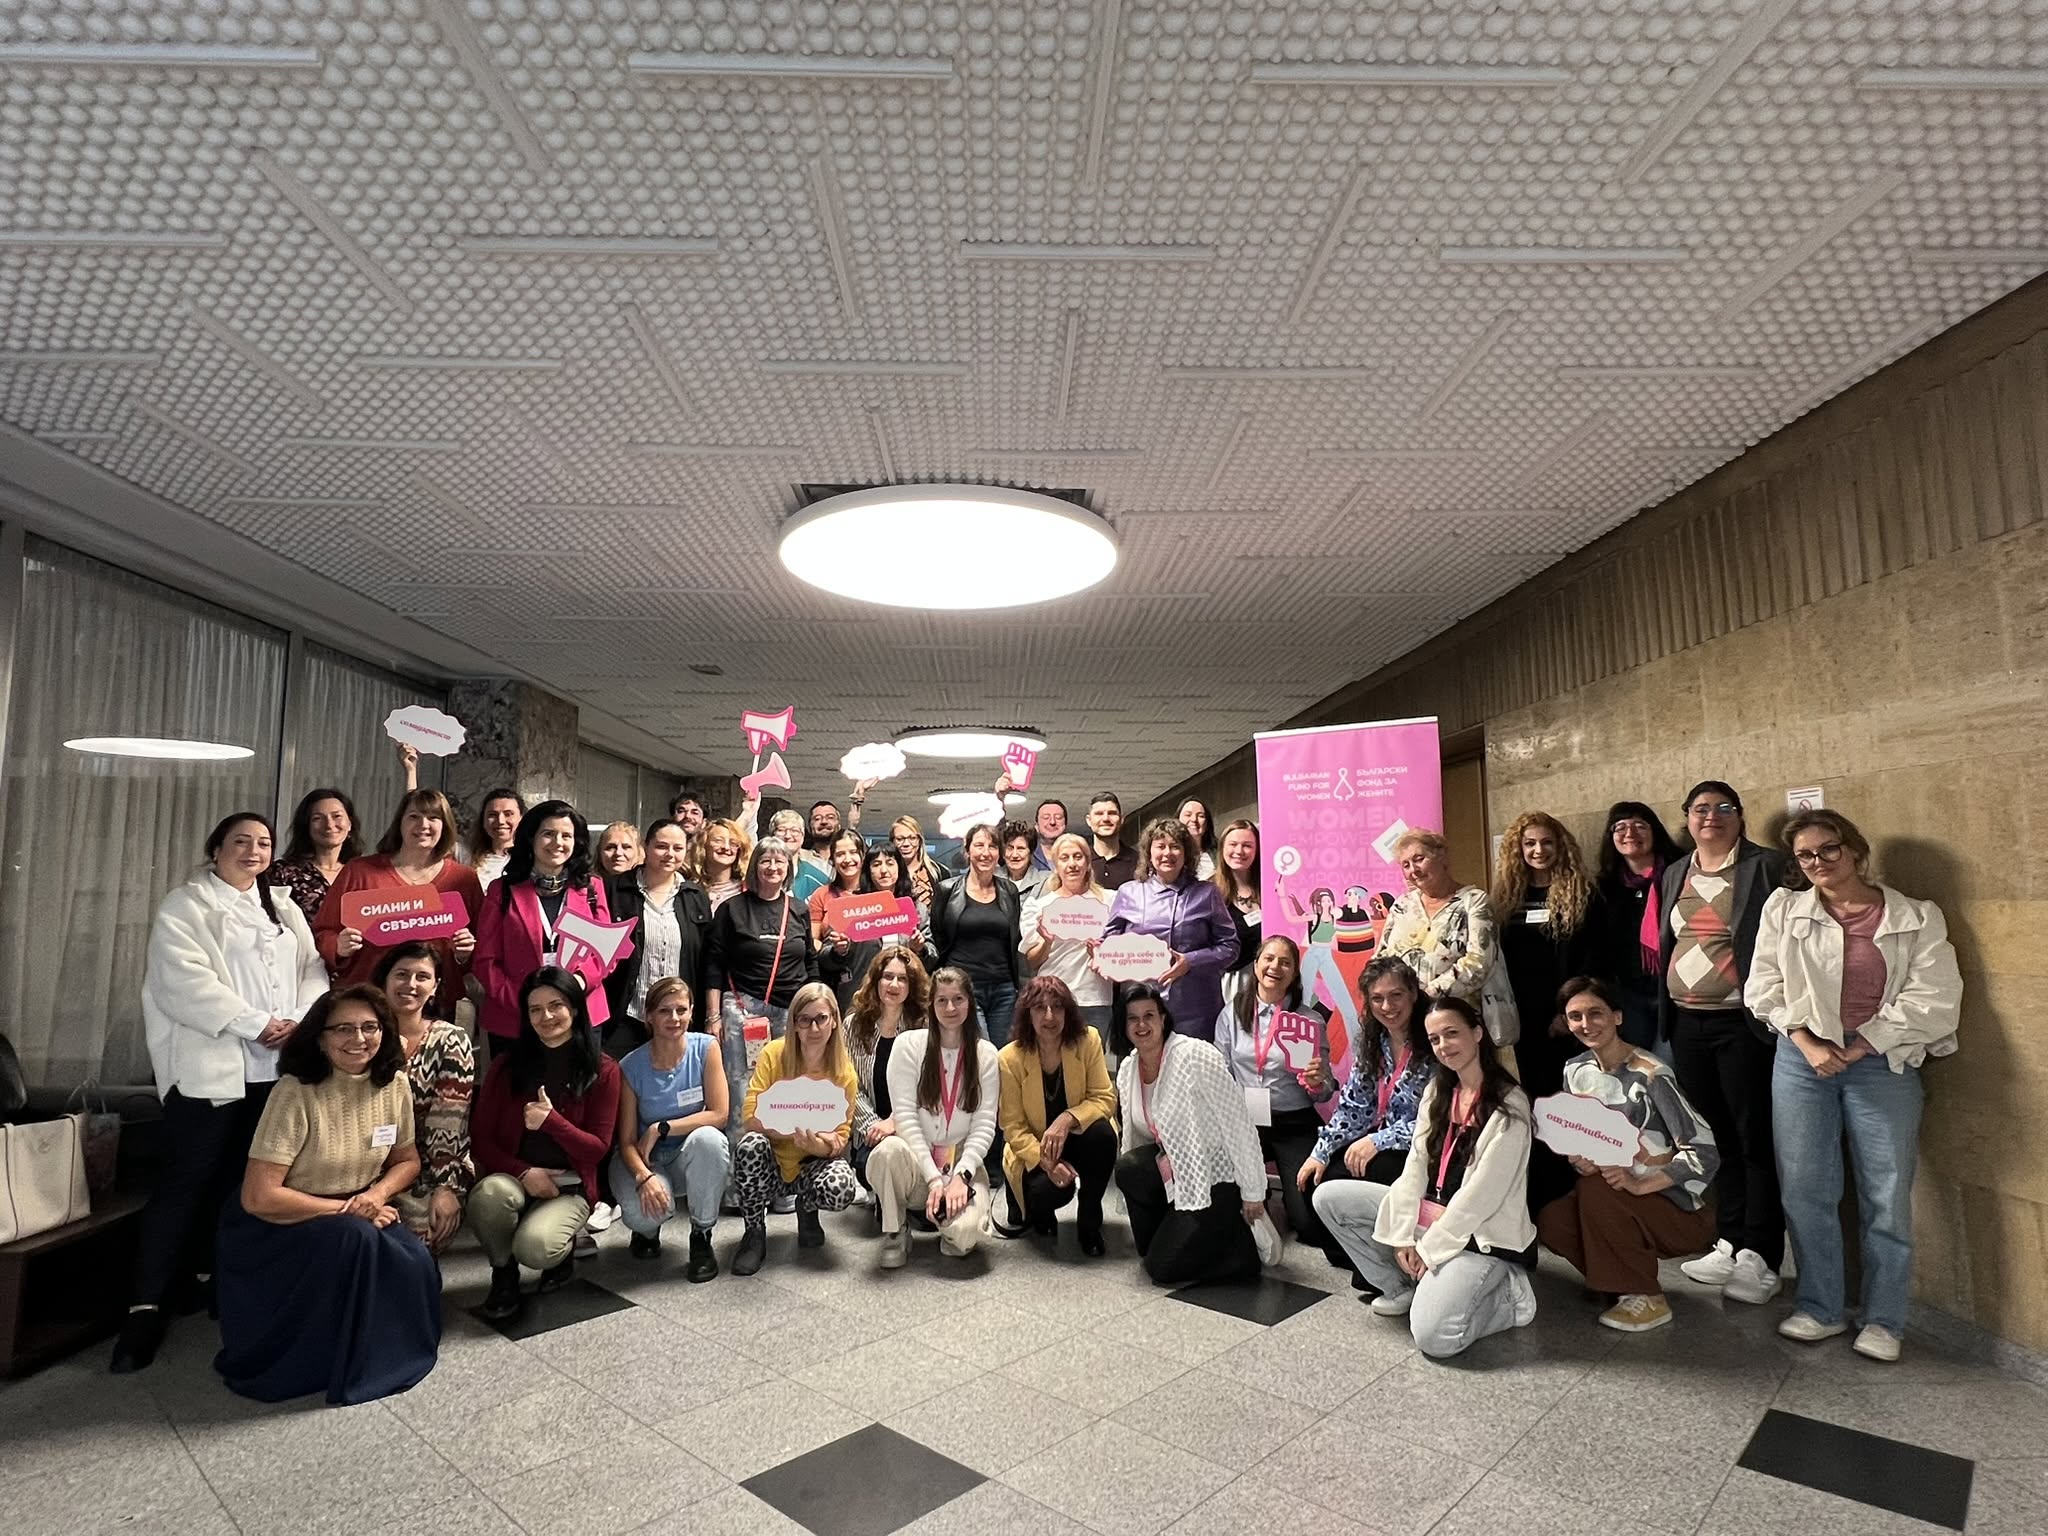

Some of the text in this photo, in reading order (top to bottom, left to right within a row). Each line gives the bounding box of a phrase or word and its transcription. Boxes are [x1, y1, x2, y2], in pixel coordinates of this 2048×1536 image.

[1356, 766, 1408, 777] БЪЛГАРСКИ
[1287, 782, 1331, 791] FUND FOR
[1356, 777, 1398, 788] ФОНД ЗА
[1296, 792, 1331, 801] WOMEN
[1357, 788, 1395, 798] ЖЕНИТЕ
[360, 899, 424, 916] СИЛНИ И
[842, 903, 883, 918] ЗАЕДНО
[379, 913, 454, 932] СВЪРЗАНИ
[855, 914, 909, 931] ПО-СИЛНИ
[1545, 1112, 1623, 1148] отзивчивост
